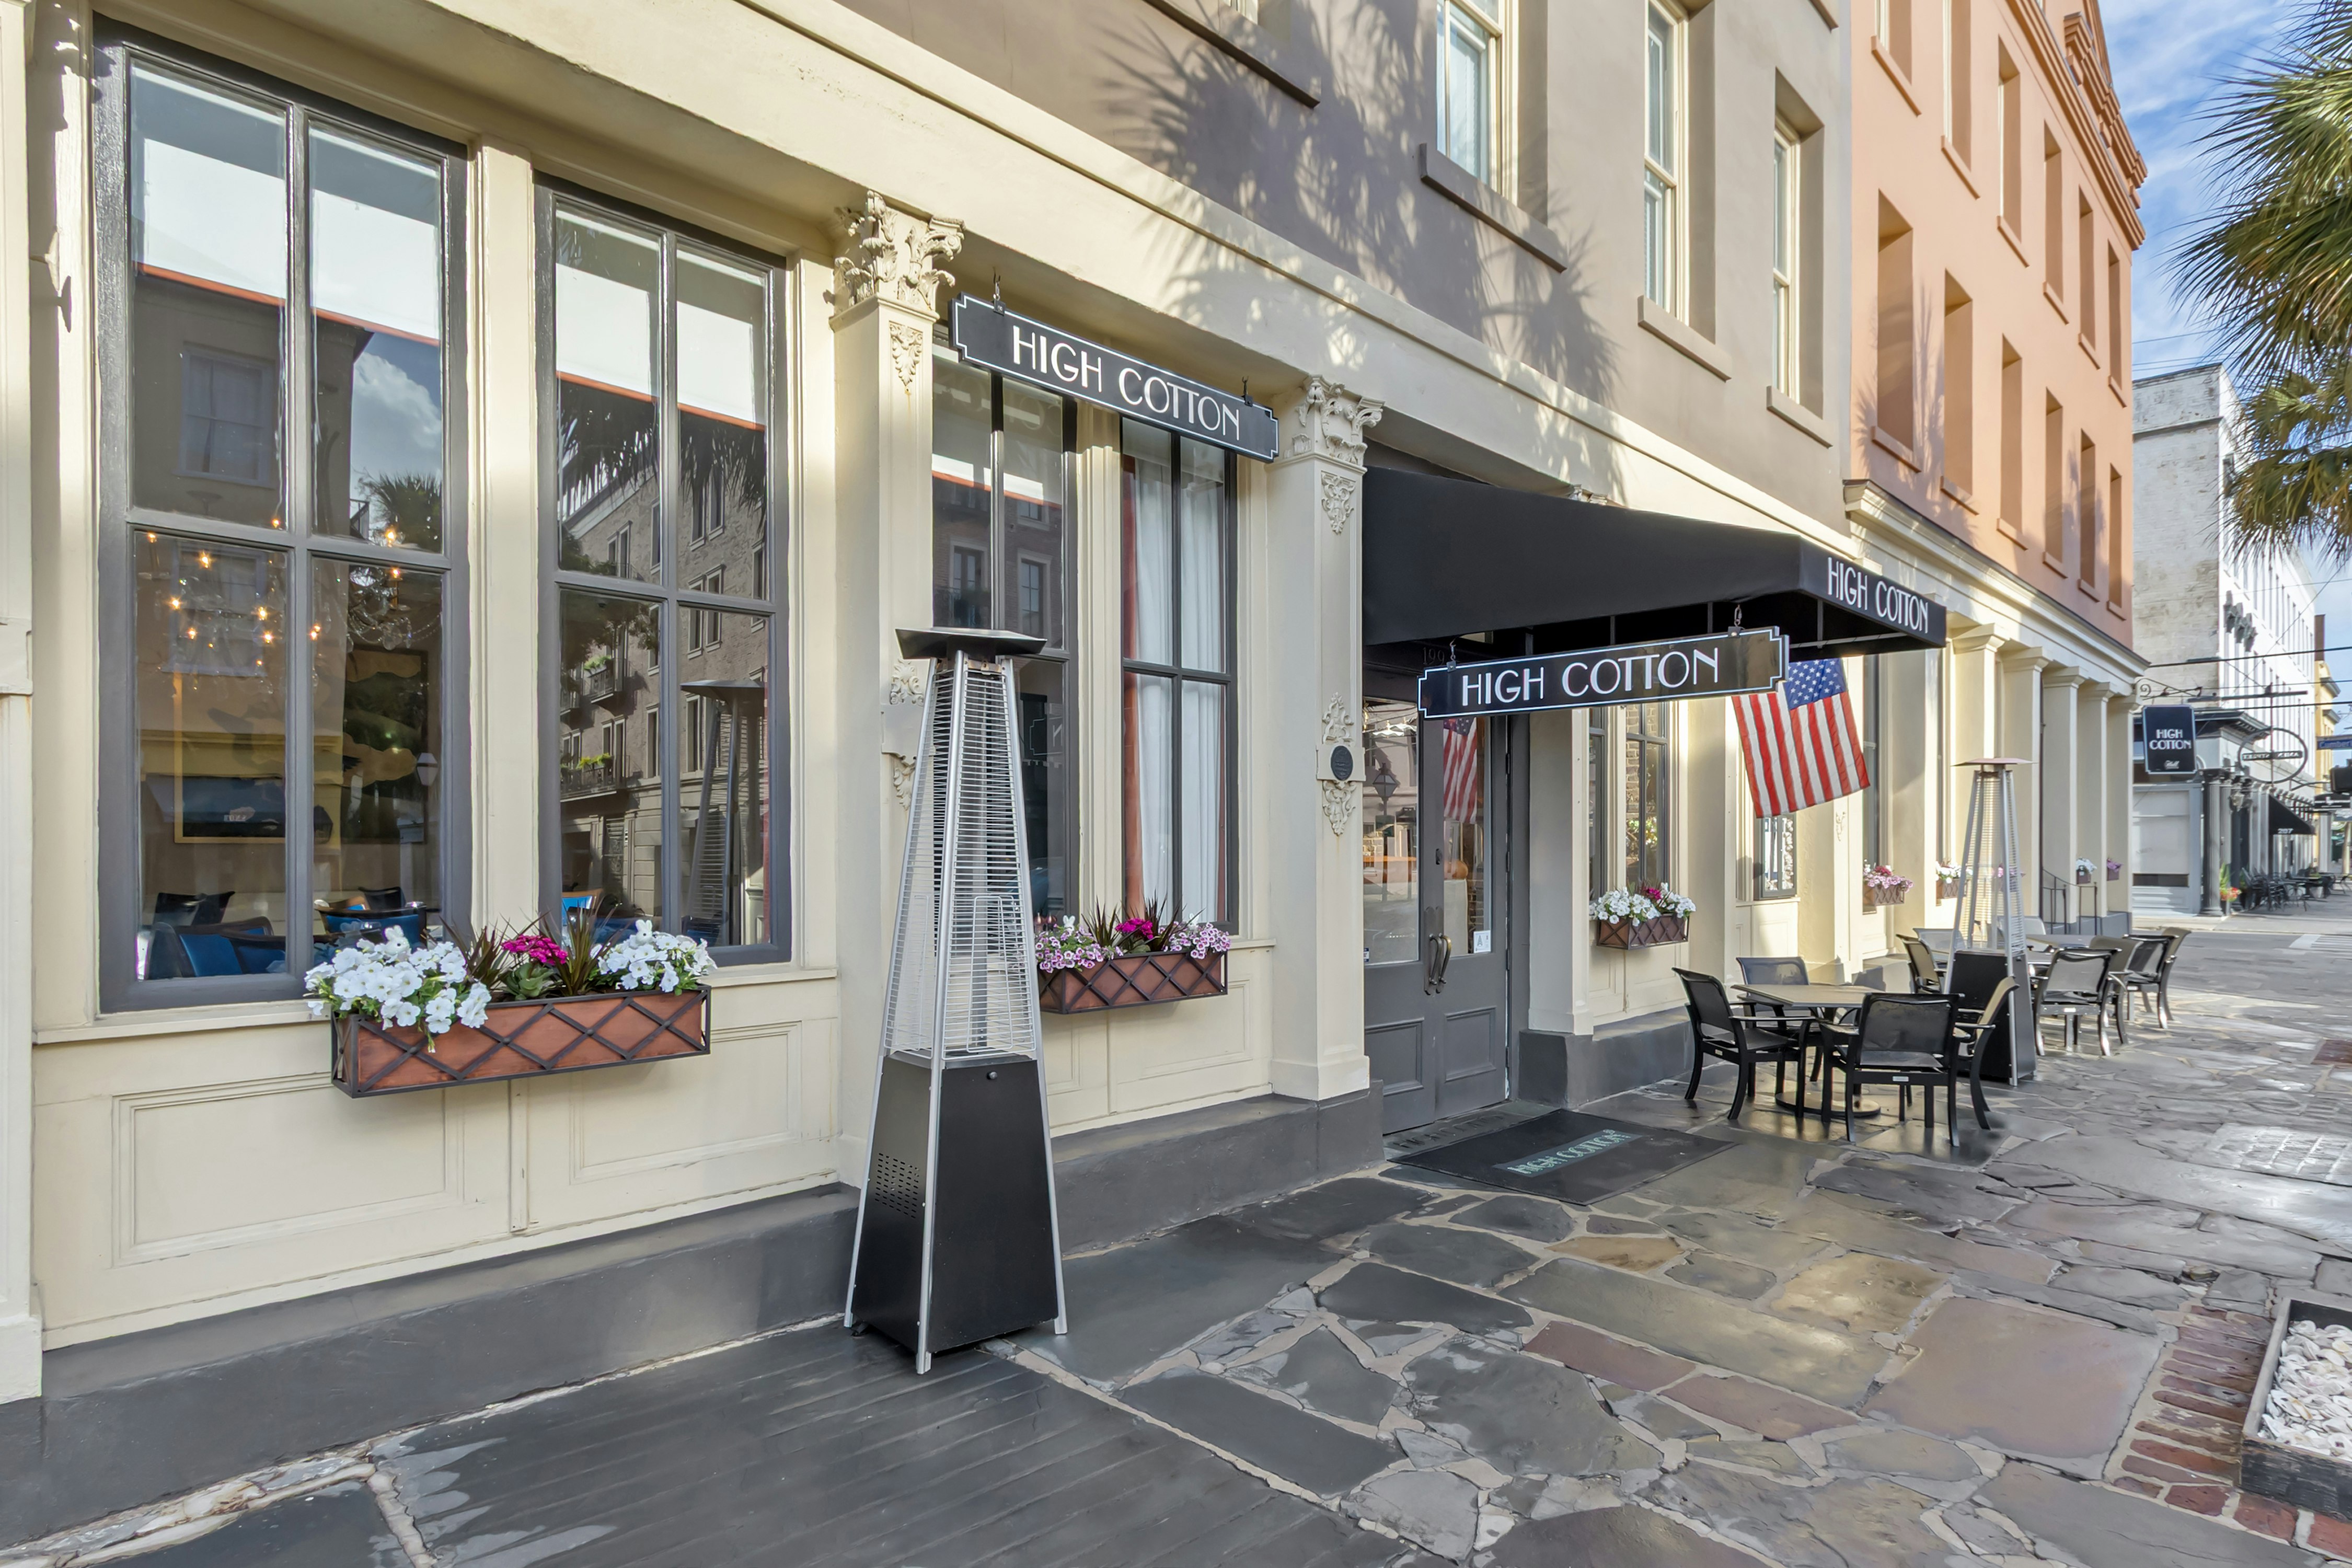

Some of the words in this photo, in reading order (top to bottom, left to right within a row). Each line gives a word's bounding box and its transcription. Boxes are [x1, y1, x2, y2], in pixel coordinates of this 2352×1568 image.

[1012, 325, 1102, 393] HIGH
[1118, 367, 1240, 441] COTTON
[1828, 557, 1868, 610] HIGH
[1875, 580, 1929, 634] COTTON
[1422, 647, 1445, 665] 199
[1462, 666, 1544, 706] HIGH
[1562, 647, 1719, 697] COTTON
[2155, 729, 2183, 739] HIGH
[2149, 740, 2192, 750] COTTON
[1507, 1156, 1568, 1174] HIGH
